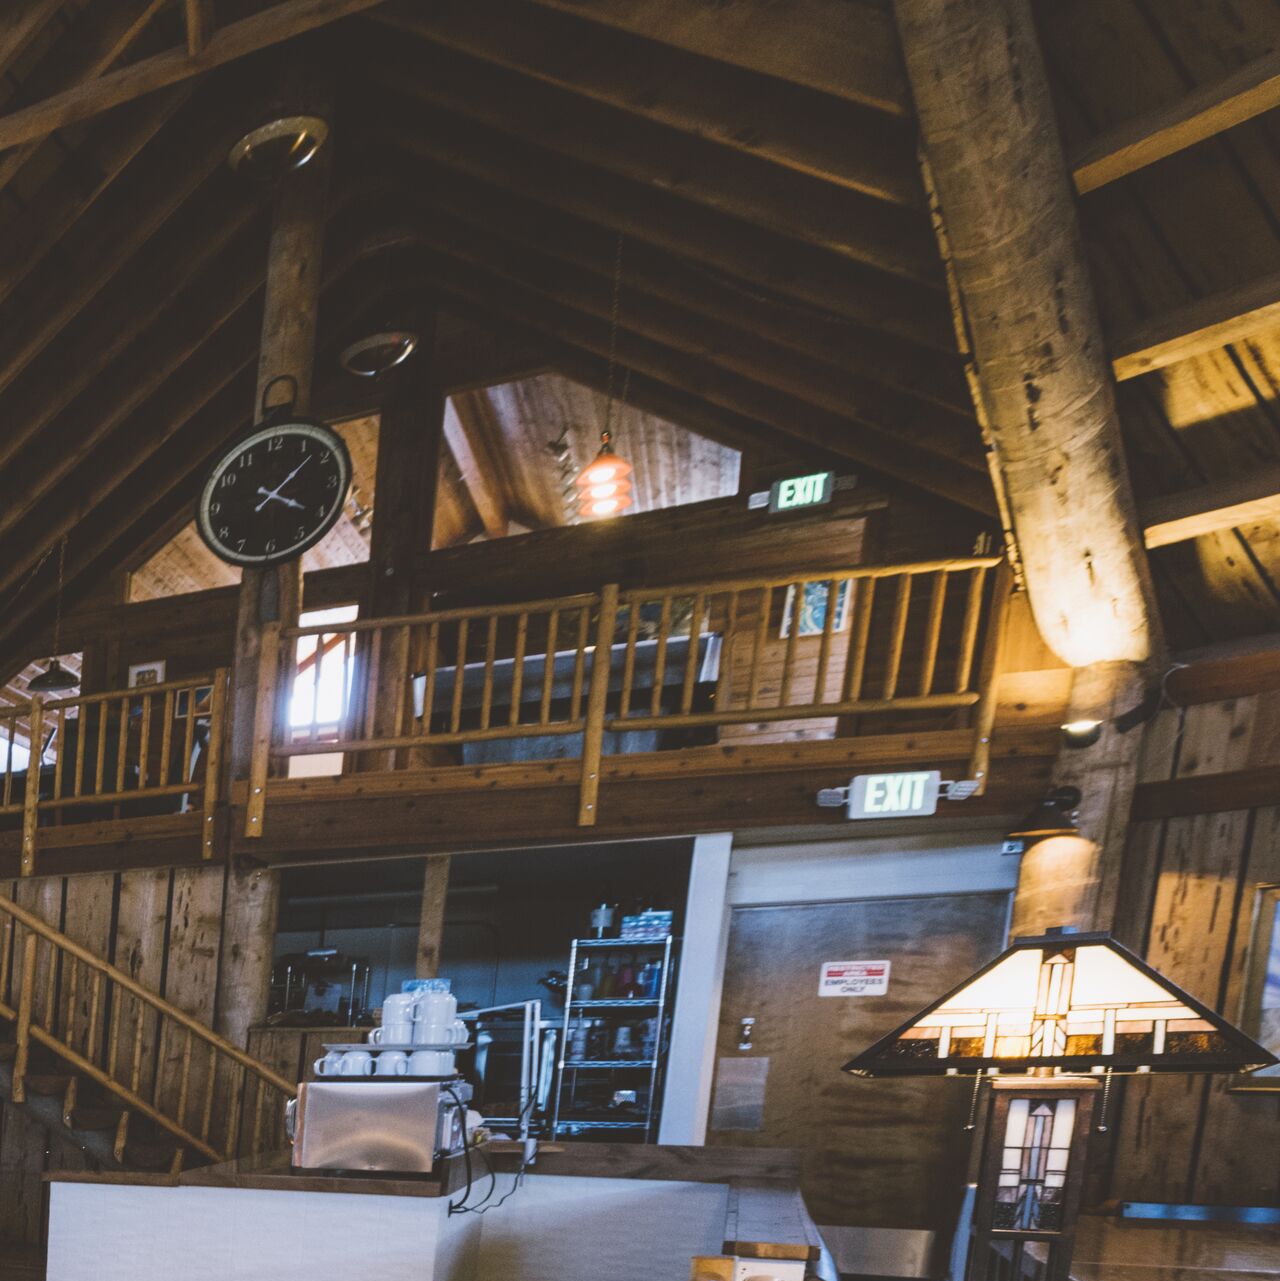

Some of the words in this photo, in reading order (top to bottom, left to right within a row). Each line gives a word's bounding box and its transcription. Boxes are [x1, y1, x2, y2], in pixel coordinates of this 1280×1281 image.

[267, 437, 283, 452] 12
[301, 440, 307, 453] 1
[240, 453, 253, 468] 11
[319, 450, 330, 464] 2
[221, 473, 237, 488] 10
[326, 475, 338, 488] 3
[778, 473, 829, 509] EXIT
[210, 503, 221, 515] 9
[316, 504, 325, 518] 4
[220, 526, 230, 538] 8
[294, 526, 305, 540] 5
[237, 538, 247, 552] 7
[265, 539, 276, 552] 6
[864, 773, 930, 812] EXIT
